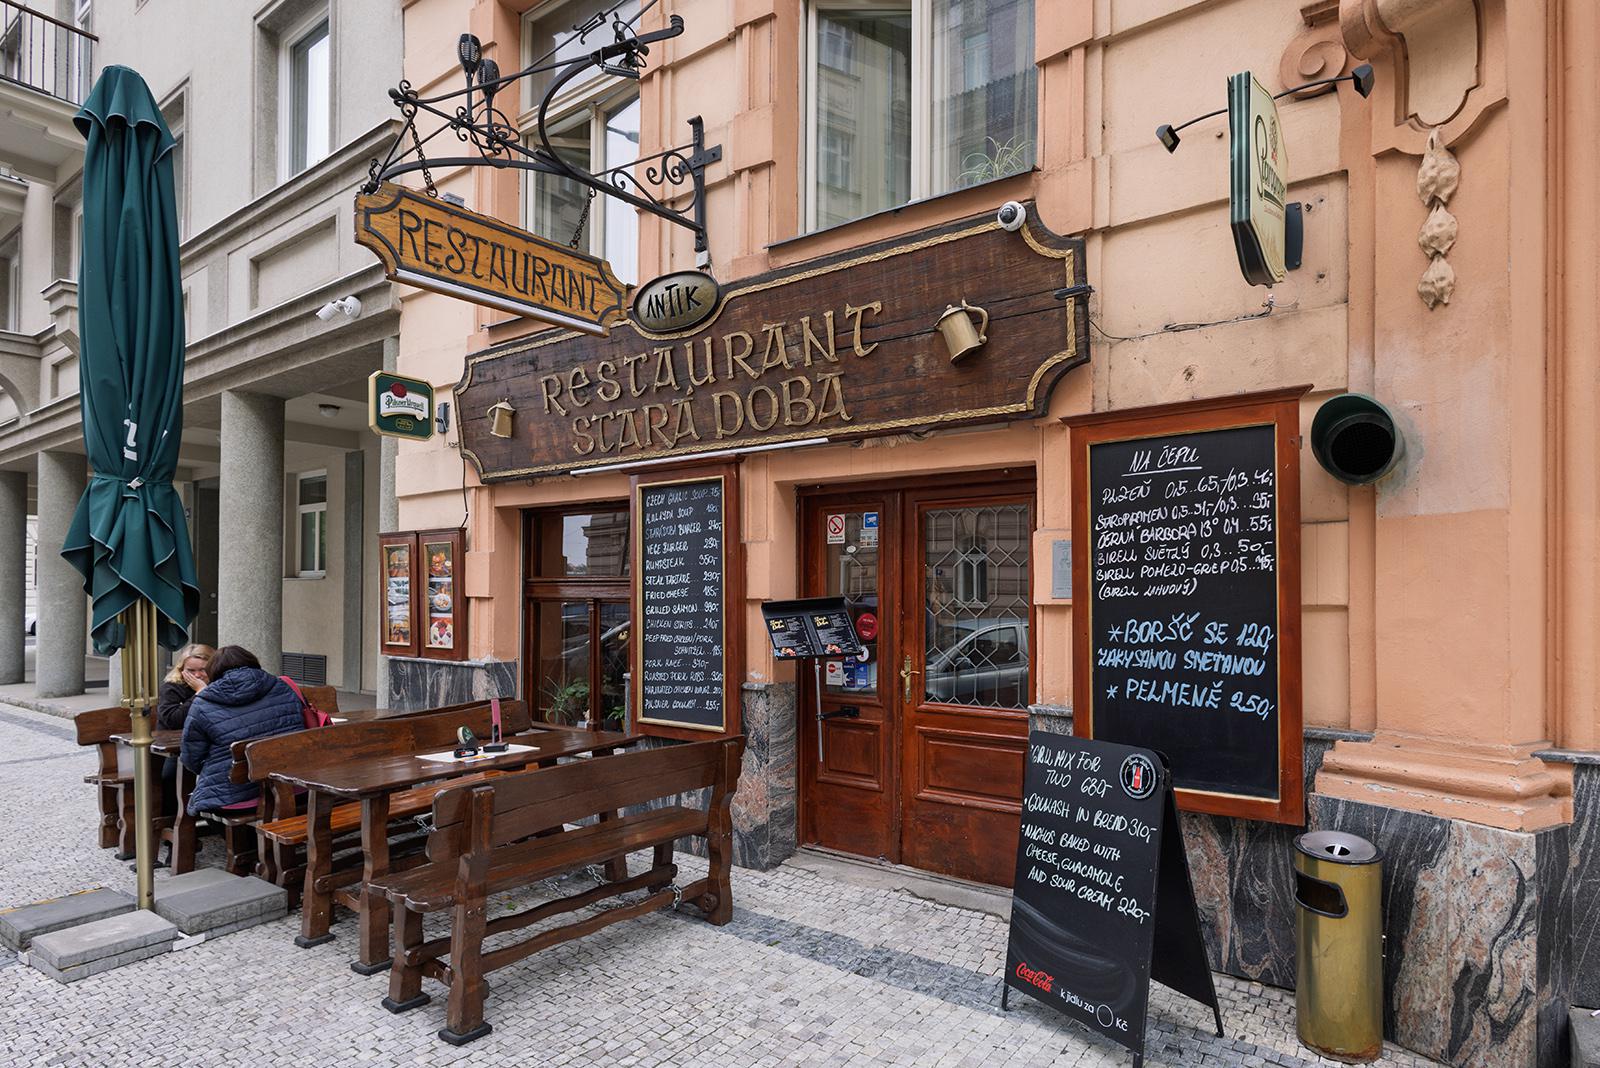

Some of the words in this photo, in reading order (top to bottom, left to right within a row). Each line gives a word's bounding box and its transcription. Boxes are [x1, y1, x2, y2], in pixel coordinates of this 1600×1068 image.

[399, 209, 606, 316] RESTAURANT
[645, 283, 702, 320] ANTIK
[572, 385, 701, 456] STARÁ
[711, 370, 853, 440] DOBA
[1129, 450, 1151, 472] NA
[1157, 445, 1200, 469] ČEPU
[1102, 479, 1152, 505] PLZEŇ
[677, 506, 694, 519] SOUP
[1095, 507, 1168, 531] STAROPRAMEN
[678, 522, 702, 536] BURGER
[1140, 522, 1197, 544] BARBORA
[662, 541, 689, 554] BURGER
[1097, 549, 1138, 566] BIRELL
[645, 557, 685, 571] RUMPSTEAK
[1096, 568, 1135, 581] BIRELL
[645, 591, 666, 600] FRIED
[666, 587, 690, 599] CHEESE
[645, 605, 671, 615] GRILLED
[671, 603, 698, 614] SALMON
[646, 619, 672, 630] CHICKEN
[673, 620, 693, 629] STRIPS
[1123, 612, 1200, 644] BORŠČ
[1203, 622, 1229, 645] SE
[645, 634, 660, 643] DEEP
[645, 659, 663, 668] PORK
[1097, 648, 1176, 670] ZAKYSANOU
[1183, 650, 1266, 676] SMETANOU
[645, 671, 669, 681] ROASTED
[670, 671, 688, 681] PORK
[1126, 678, 1224, 709] PELMENĚ
[1054, 750, 1076, 770] MIX
[1077, 751, 1101, 772] FOR
[1045, 769, 1071, 788] TWO
[1076, 807, 1090, 823] IN
[1093, 811, 1128, 832] BREAD
[1060, 833, 1091, 853] BAKED
[1093, 844, 1121, 861] WITH
[1028, 866, 1048, 884] AND
[1050, 874, 1076, 893] SOUR
[1077, 886, 1115, 912] CREAM
[1060, 989, 1066, 999] k
[1065, 991, 1083, 1008] jídlu
[1084, 1002, 1095, 1013] za
[1115, 1017, 1128, 1032] Kč
